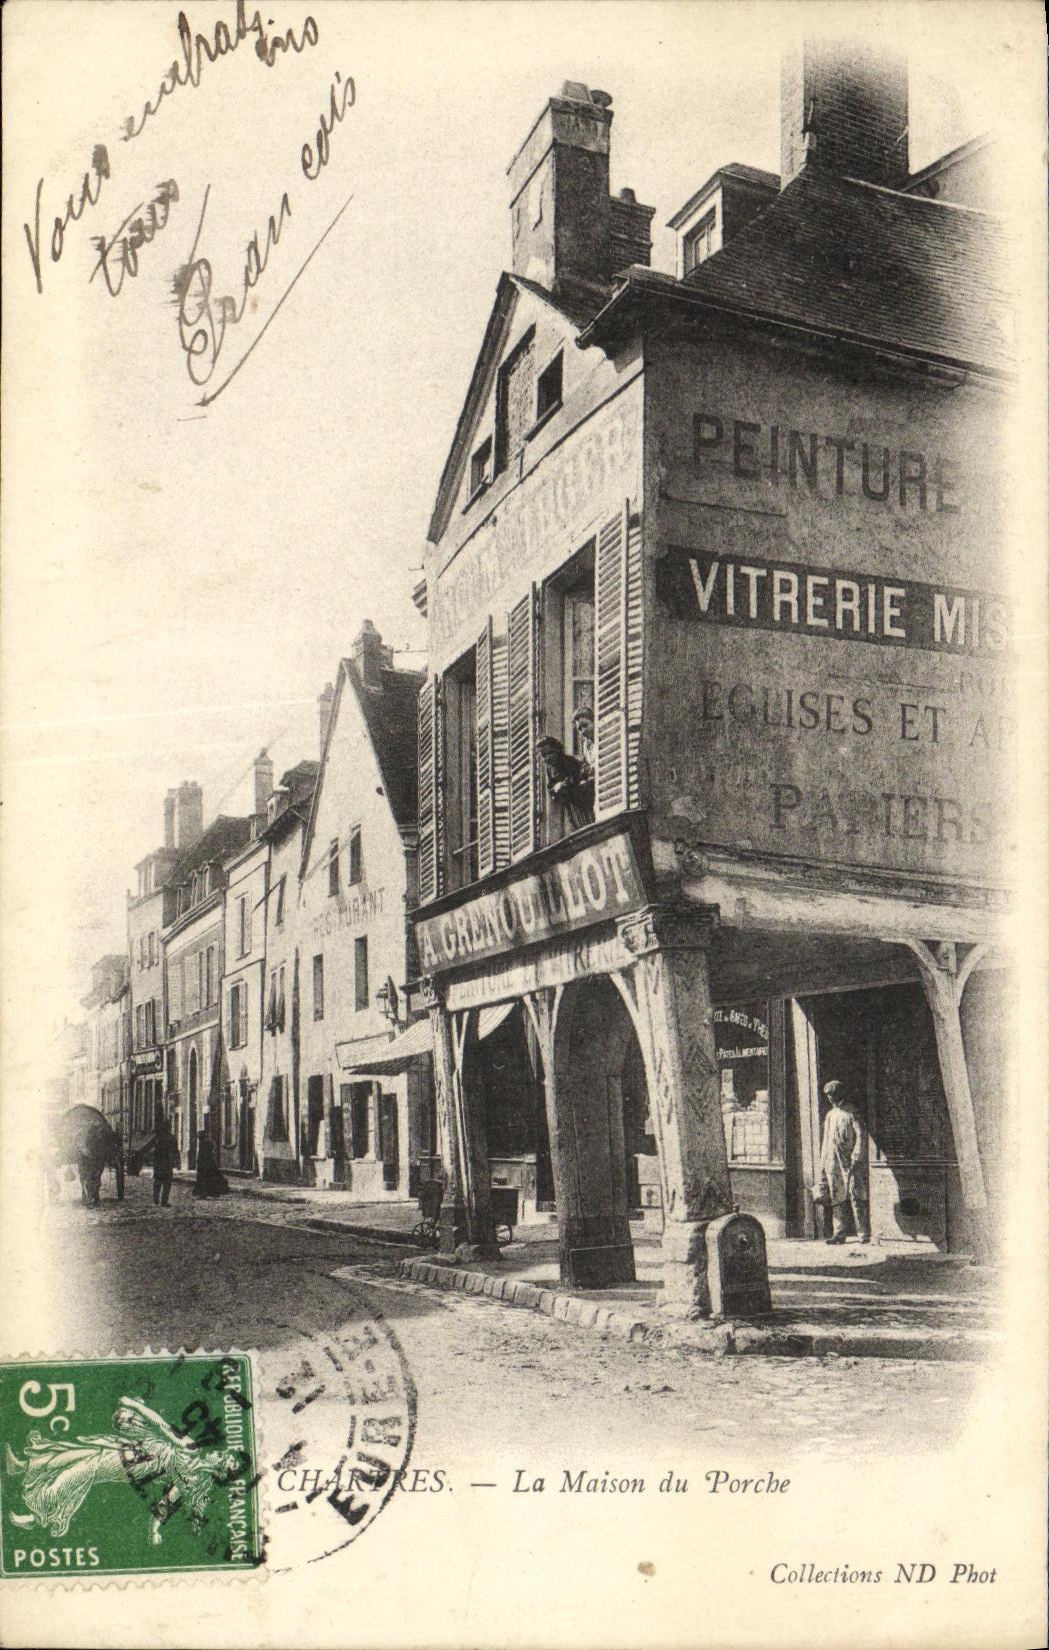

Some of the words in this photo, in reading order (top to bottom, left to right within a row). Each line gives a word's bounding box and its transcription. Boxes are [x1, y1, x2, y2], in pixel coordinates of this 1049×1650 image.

[688, 557, 907, 638] VITRERIE
[899, 703, 946, 744] ET
[13, 1547, 101, 1569] POSTES
